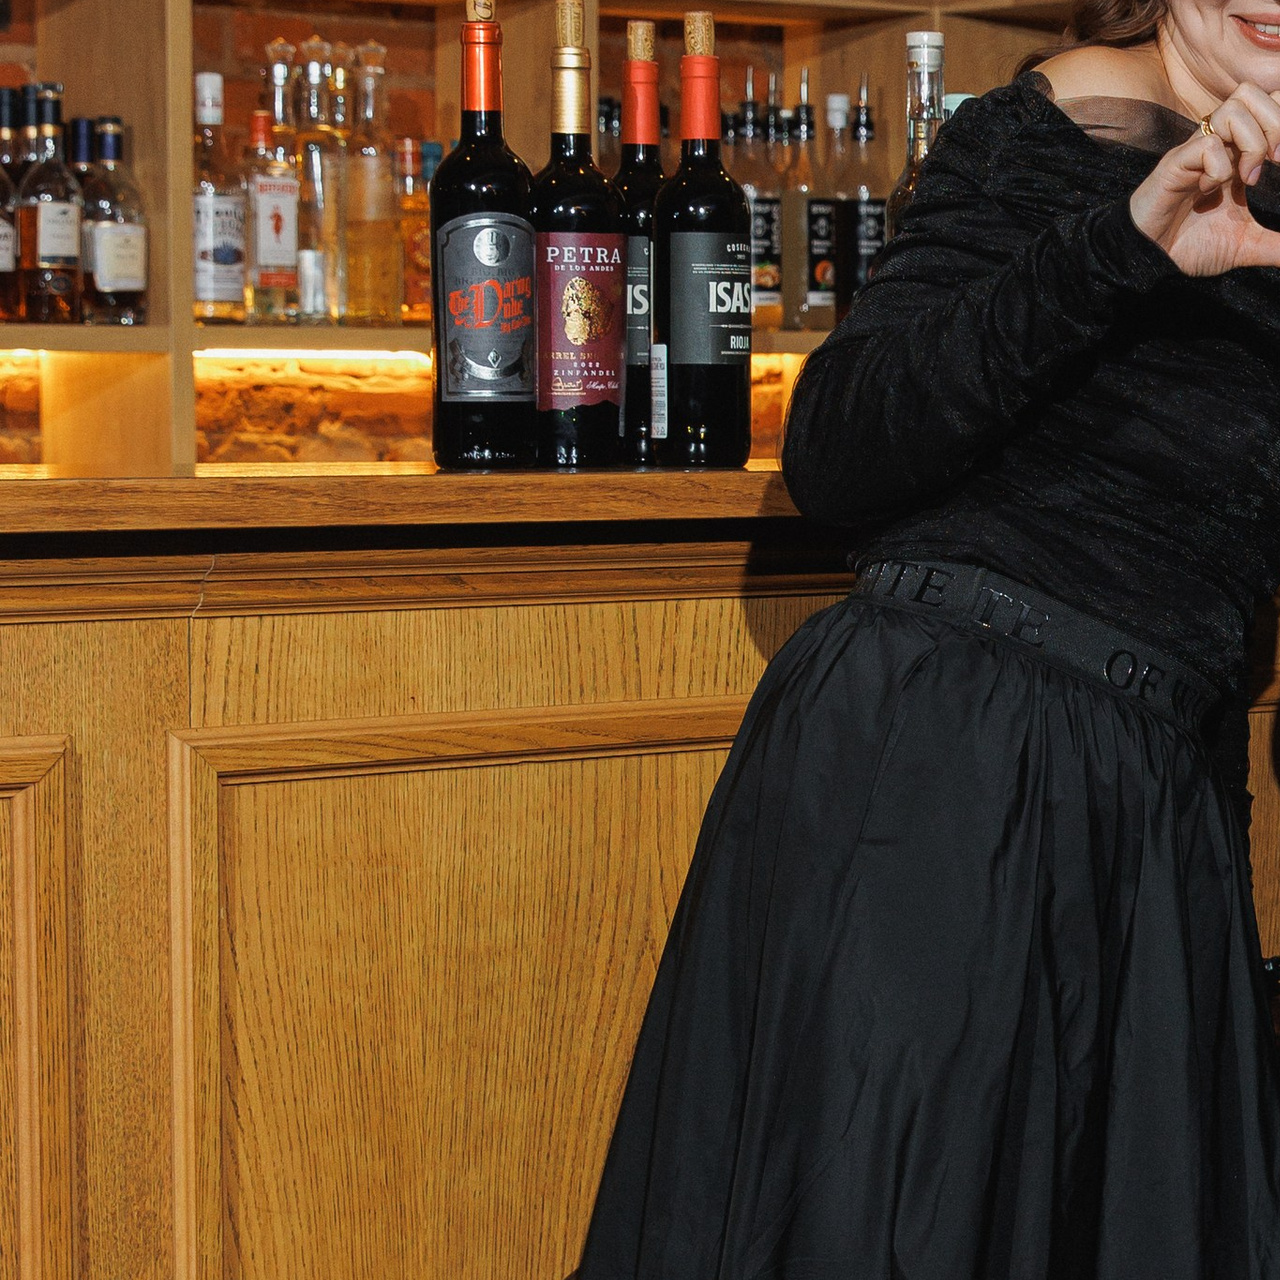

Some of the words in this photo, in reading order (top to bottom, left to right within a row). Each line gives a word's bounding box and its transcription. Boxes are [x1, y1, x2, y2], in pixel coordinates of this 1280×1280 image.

[546, 246, 622, 264] PETRA
[569, 264, 586, 272] LOS
[730, 335, 750, 350] RIOJA
[553, 369, 616, 377] ZINFANDEL
